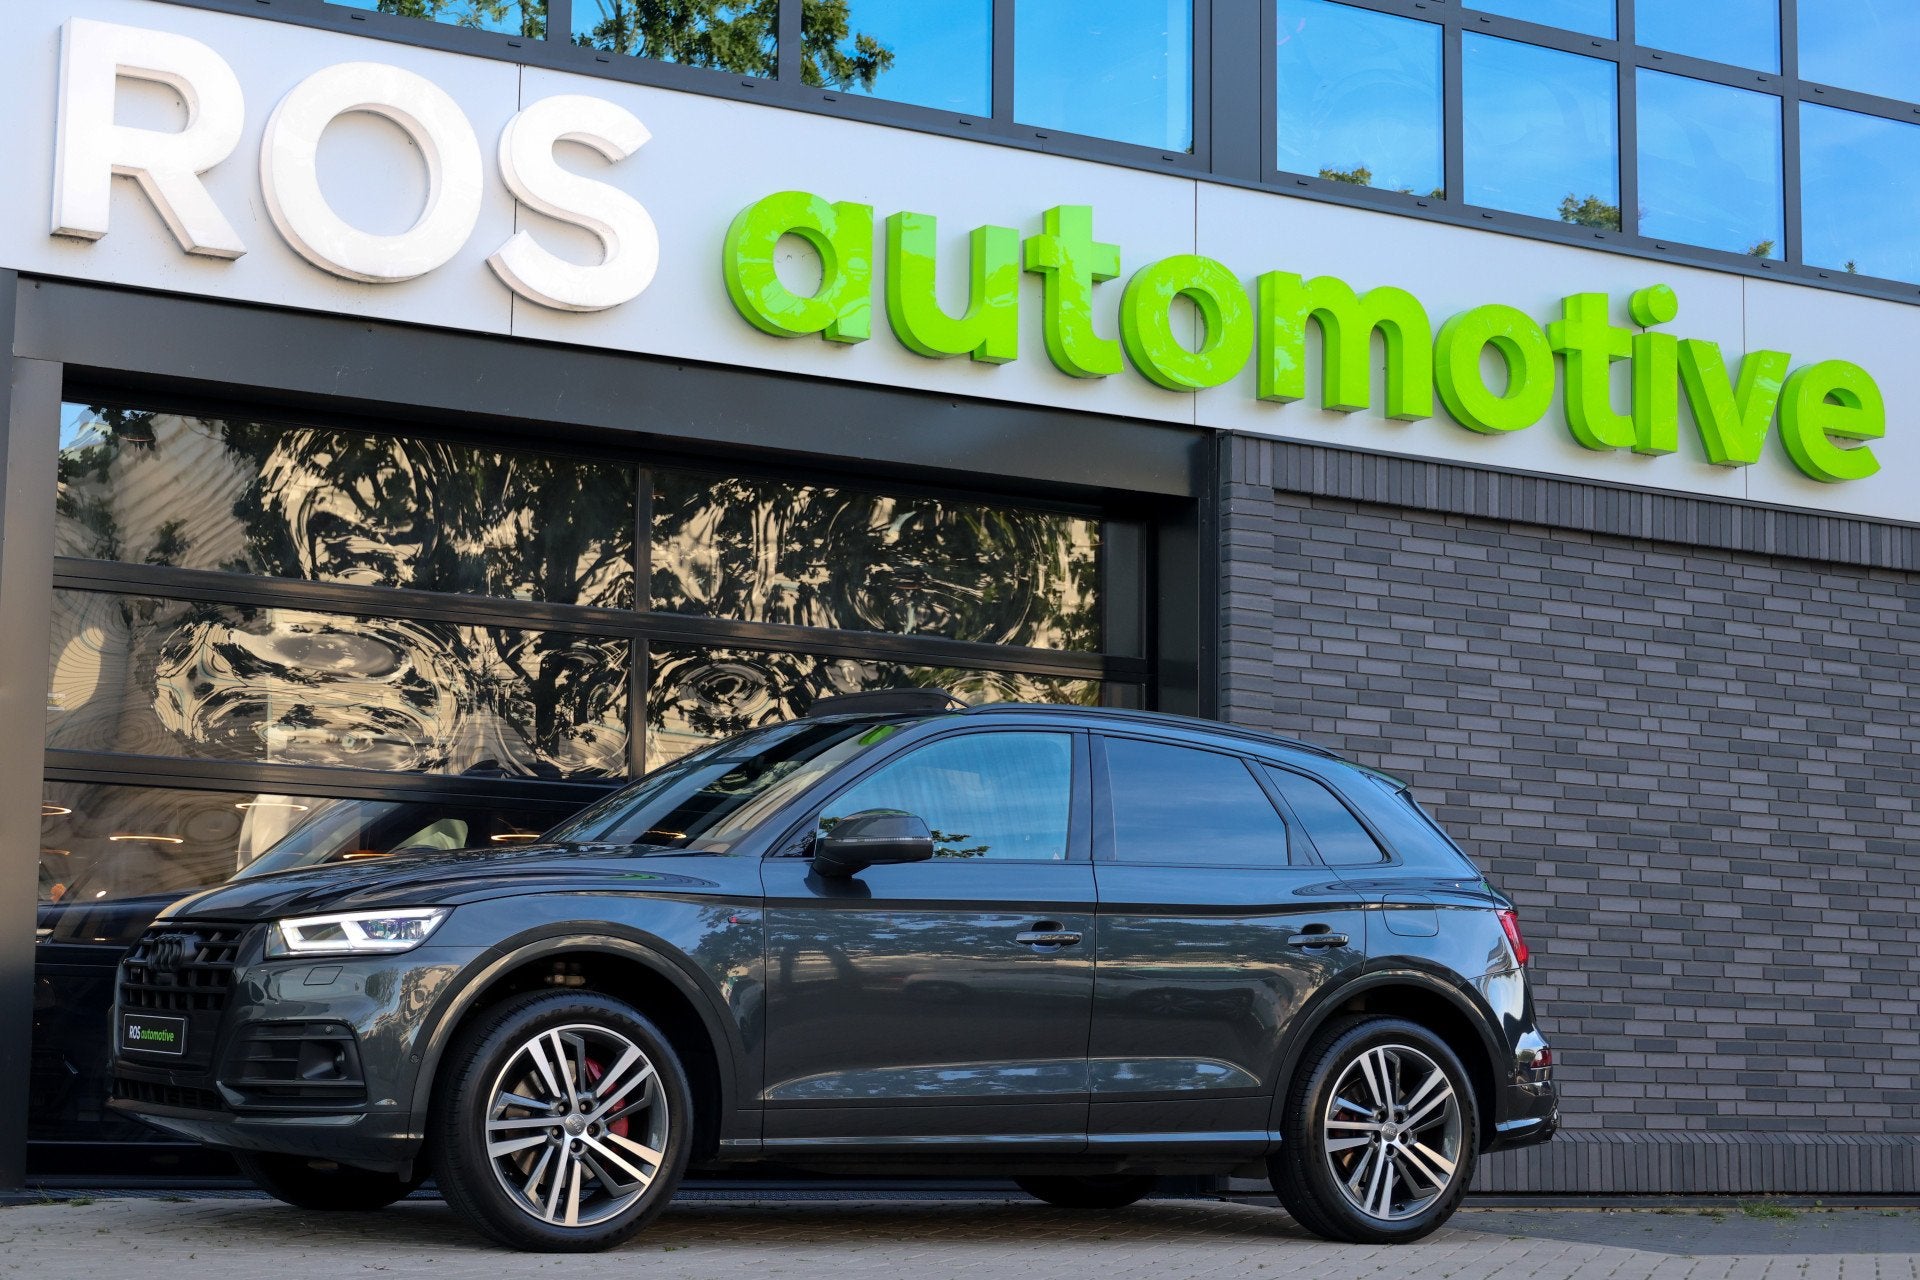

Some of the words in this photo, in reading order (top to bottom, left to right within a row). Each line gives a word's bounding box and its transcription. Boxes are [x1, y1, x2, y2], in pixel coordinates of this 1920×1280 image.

[50, 16, 660, 313] ROS
[723, 191, 1887, 484] automotive
[128, 1025, 141, 1040] ROS
[141, 1028, 175, 1042] automotive
